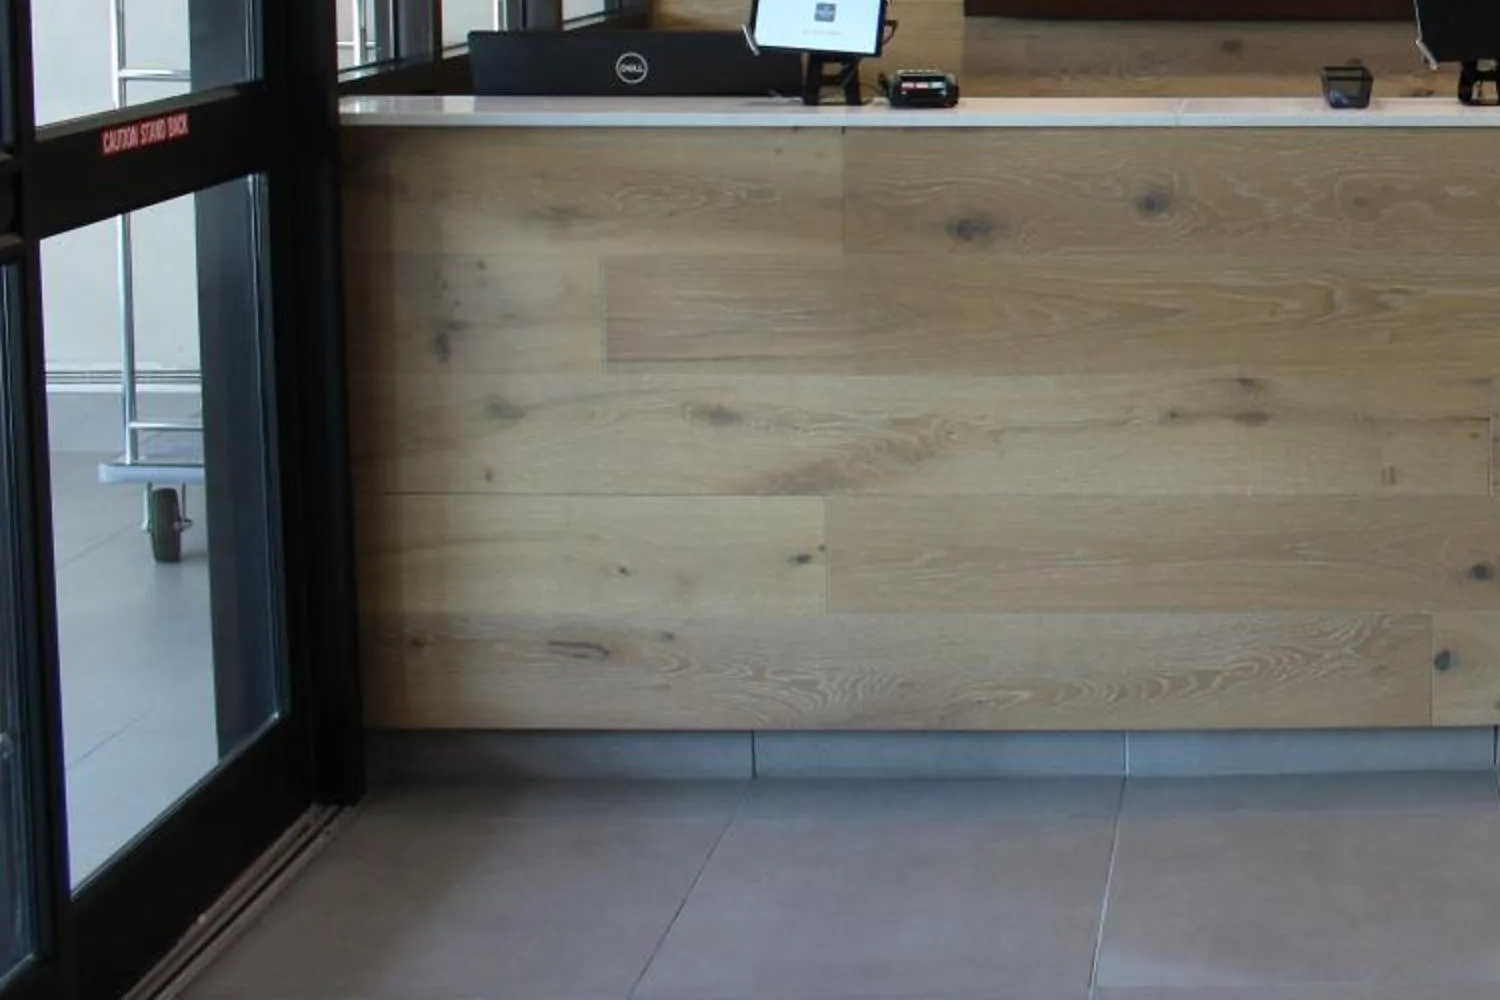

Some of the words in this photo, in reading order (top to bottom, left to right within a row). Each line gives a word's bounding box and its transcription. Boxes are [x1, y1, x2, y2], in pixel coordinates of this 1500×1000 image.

[103, 125, 139, 153] CAUTION
[140, 118, 167, 146] STAND
[167, 112, 189, 138] BACK
